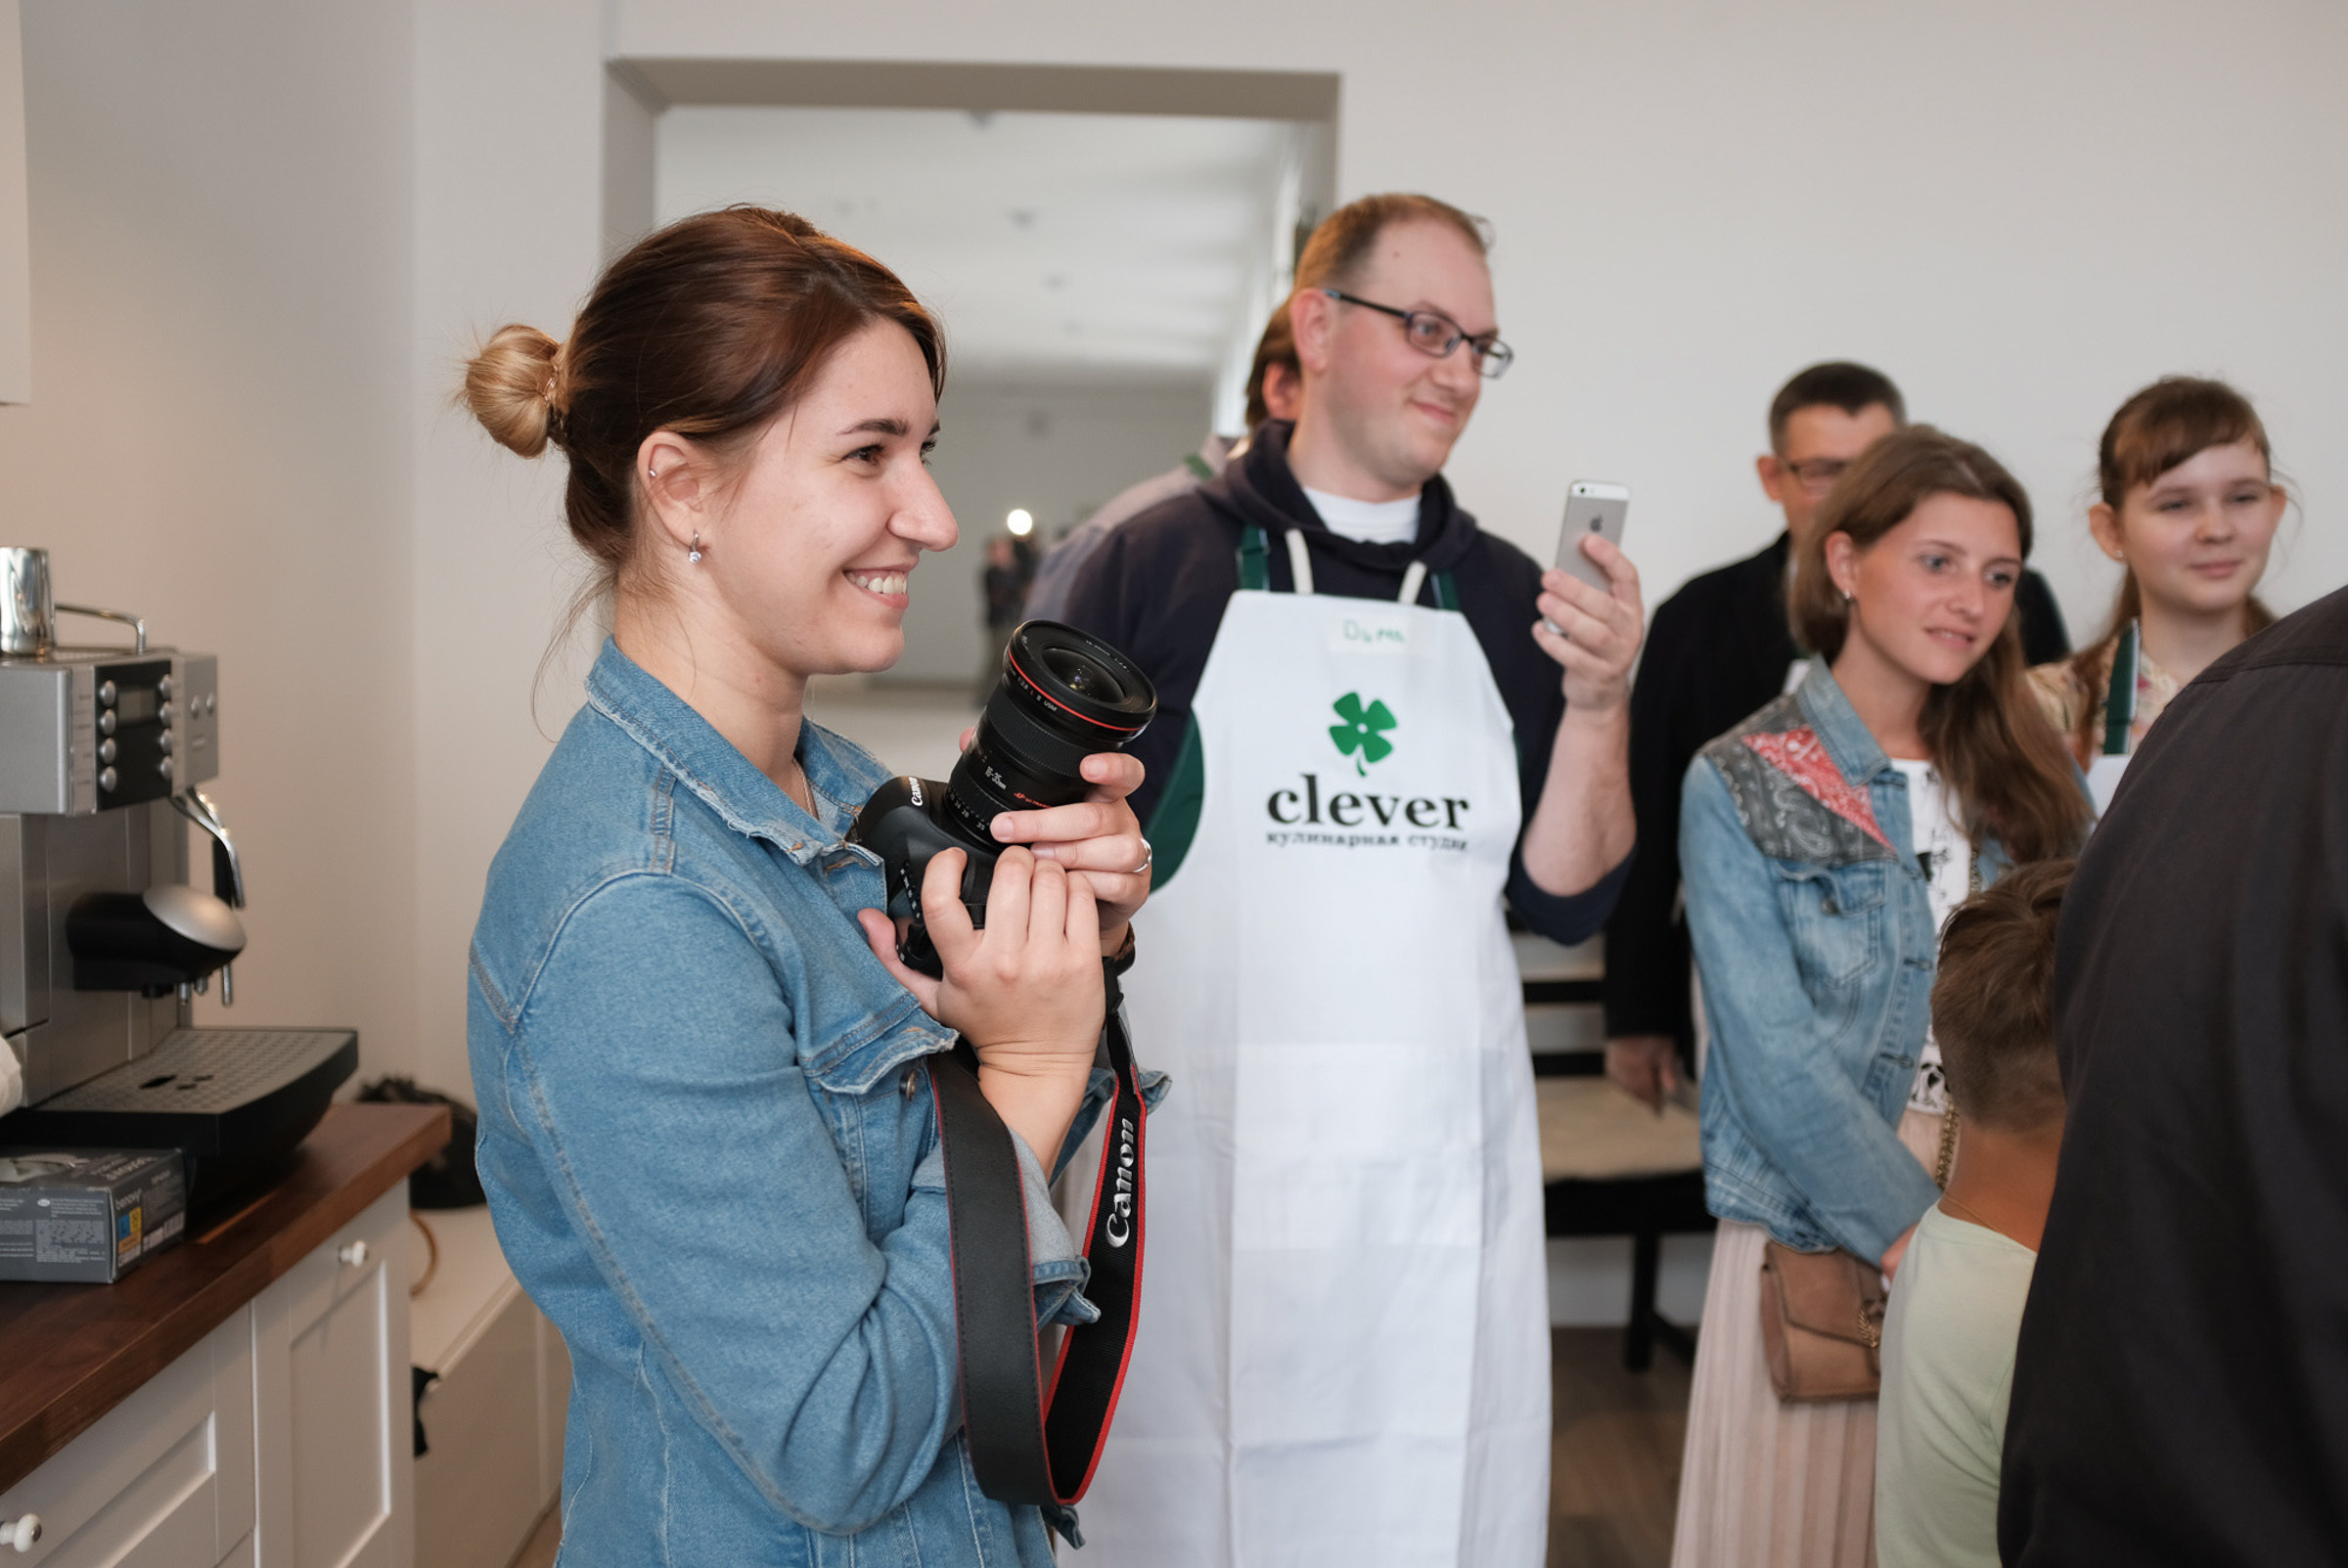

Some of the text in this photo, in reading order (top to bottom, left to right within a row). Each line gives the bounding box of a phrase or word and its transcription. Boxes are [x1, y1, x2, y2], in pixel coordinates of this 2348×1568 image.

[1268, 773, 1469, 829] clever
[1267, 832, 1400, 847] кулинарная
[1106, 1117, 1135, 1249] Canon
